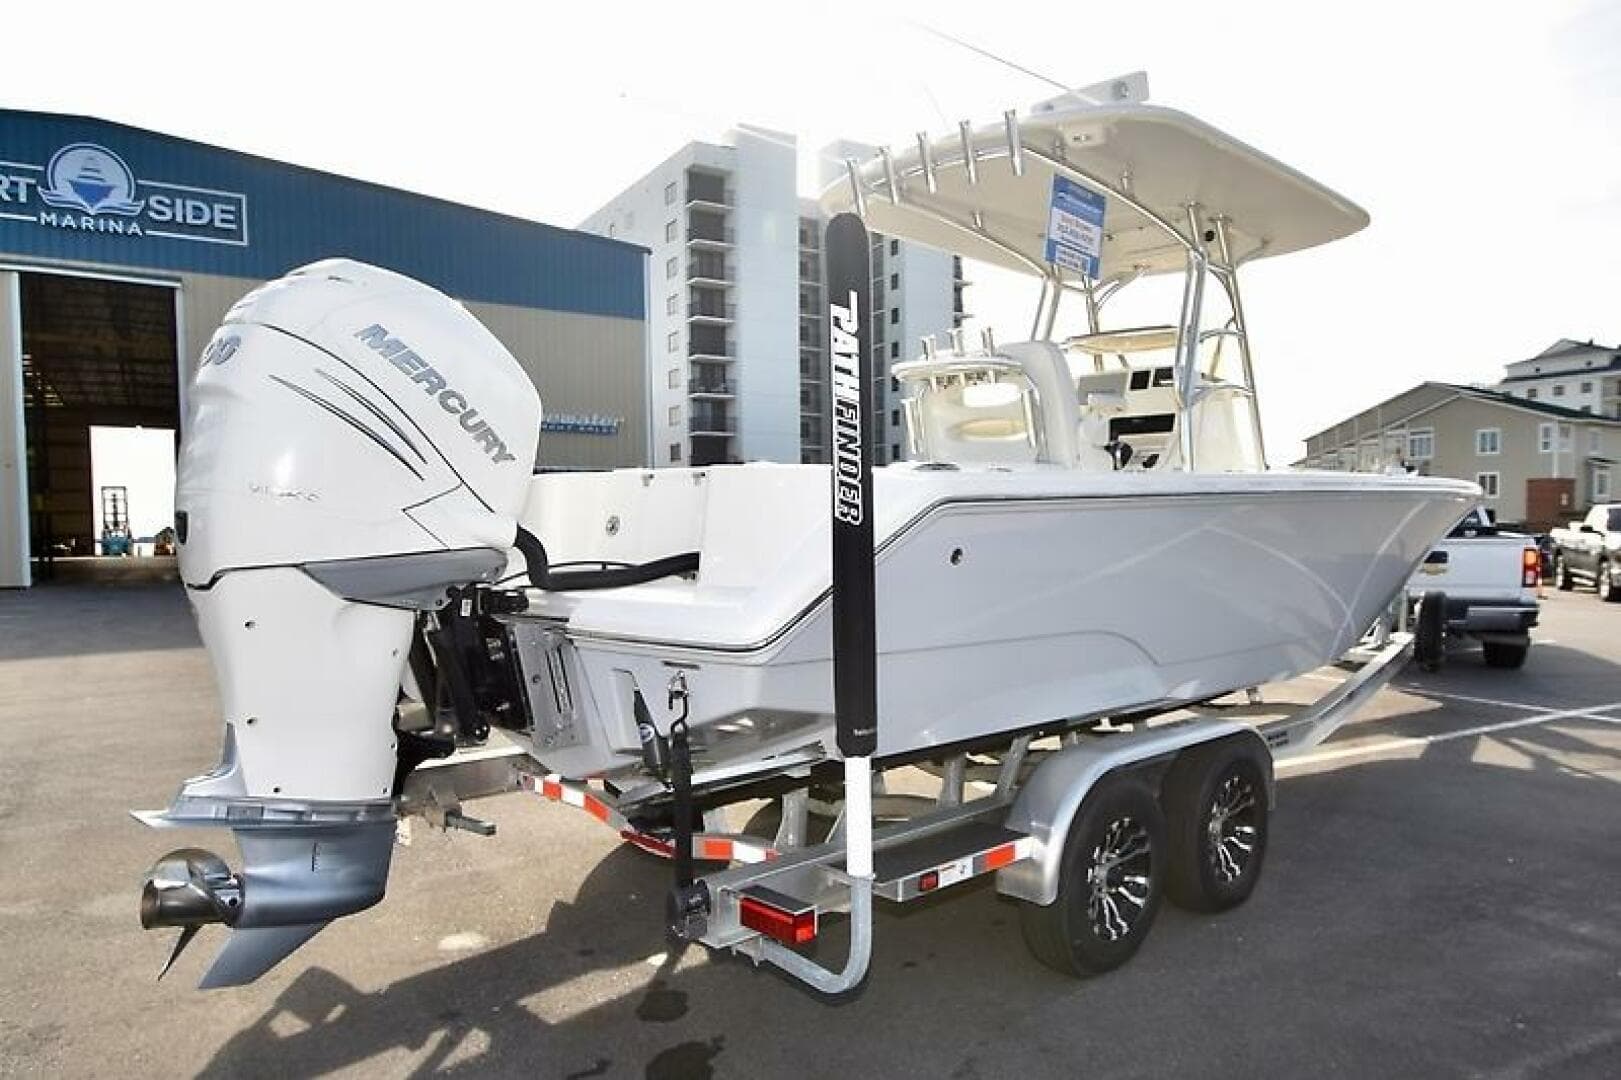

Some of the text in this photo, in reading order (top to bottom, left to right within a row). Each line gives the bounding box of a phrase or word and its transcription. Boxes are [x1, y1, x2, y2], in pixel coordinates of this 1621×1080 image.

[39, 211, 144, 237] MARINA
[148, 194, 238, 230] SIDE
[354, 322, 517, 466] MERCURY
[830, 289, 864, 527] PATHFINDER
